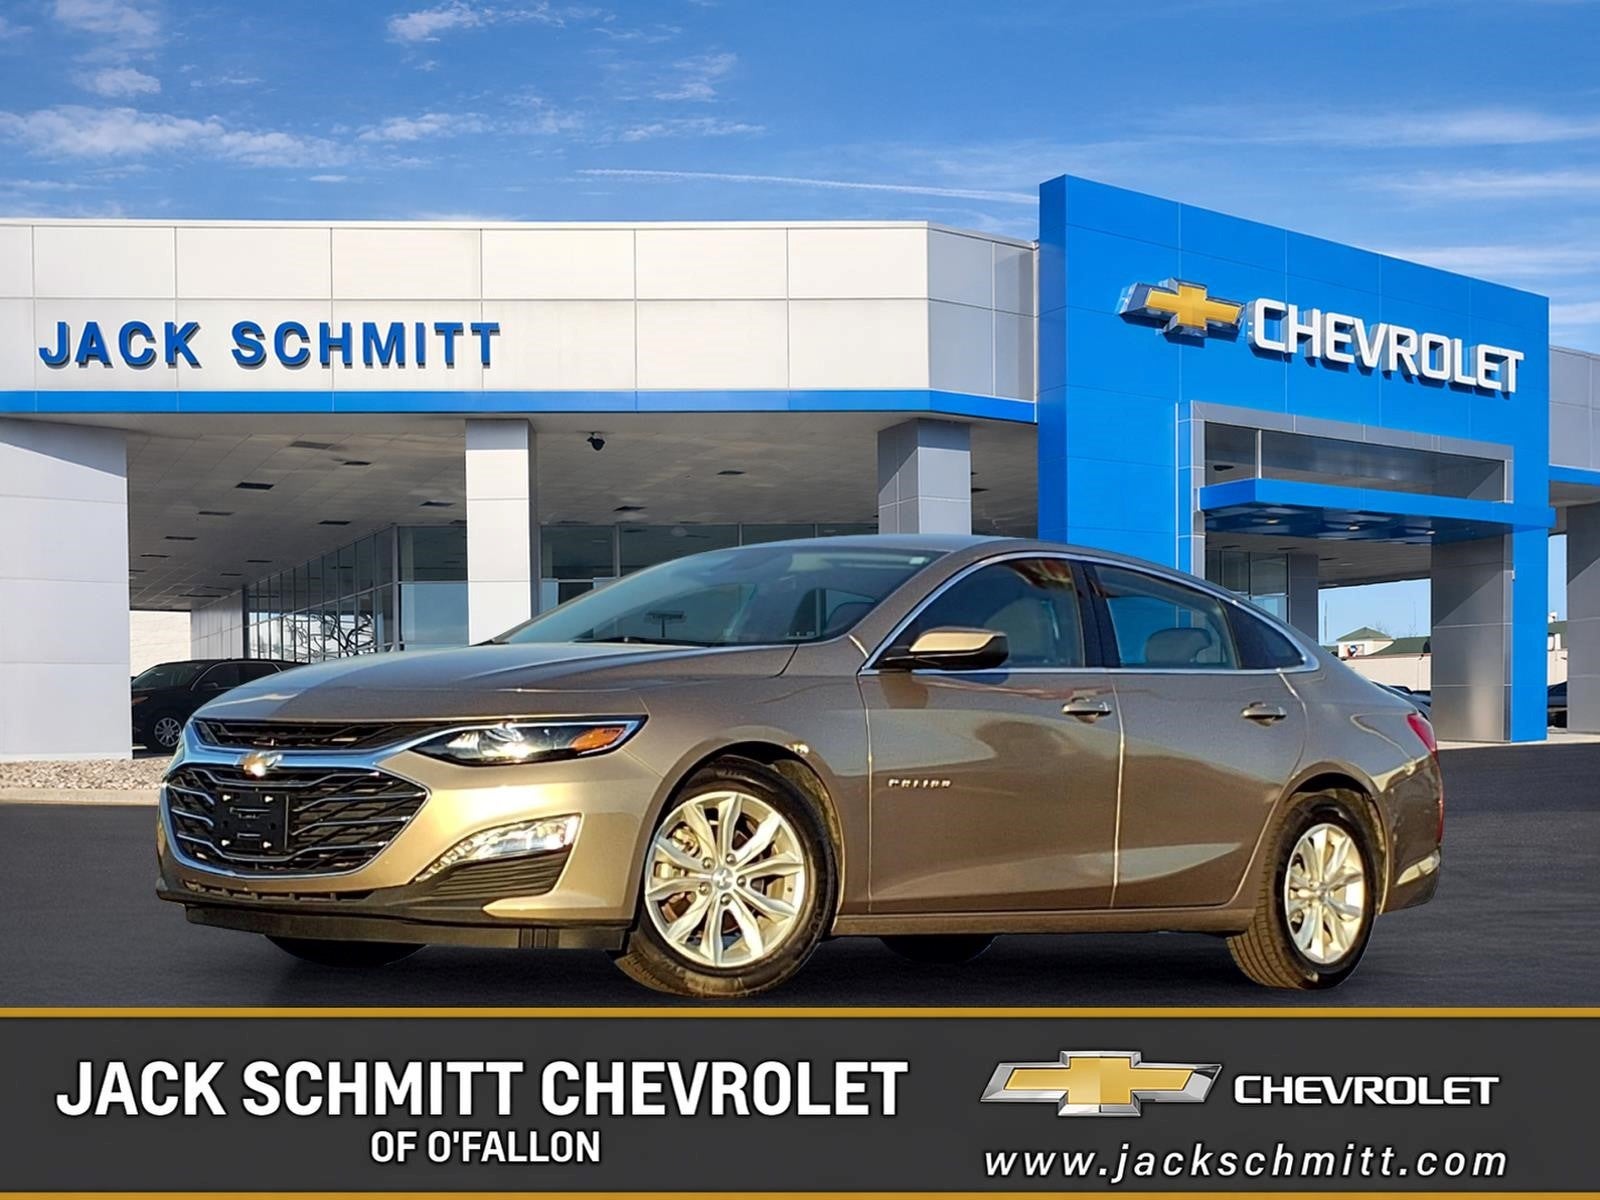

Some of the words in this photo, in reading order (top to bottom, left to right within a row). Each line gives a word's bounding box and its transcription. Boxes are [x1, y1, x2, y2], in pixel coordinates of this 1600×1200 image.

[38, 320, 201, 369] JACK
[231, 320, 501, 369] SCHMITT
[1248, 297, 1525, 393] CHEVROLET
